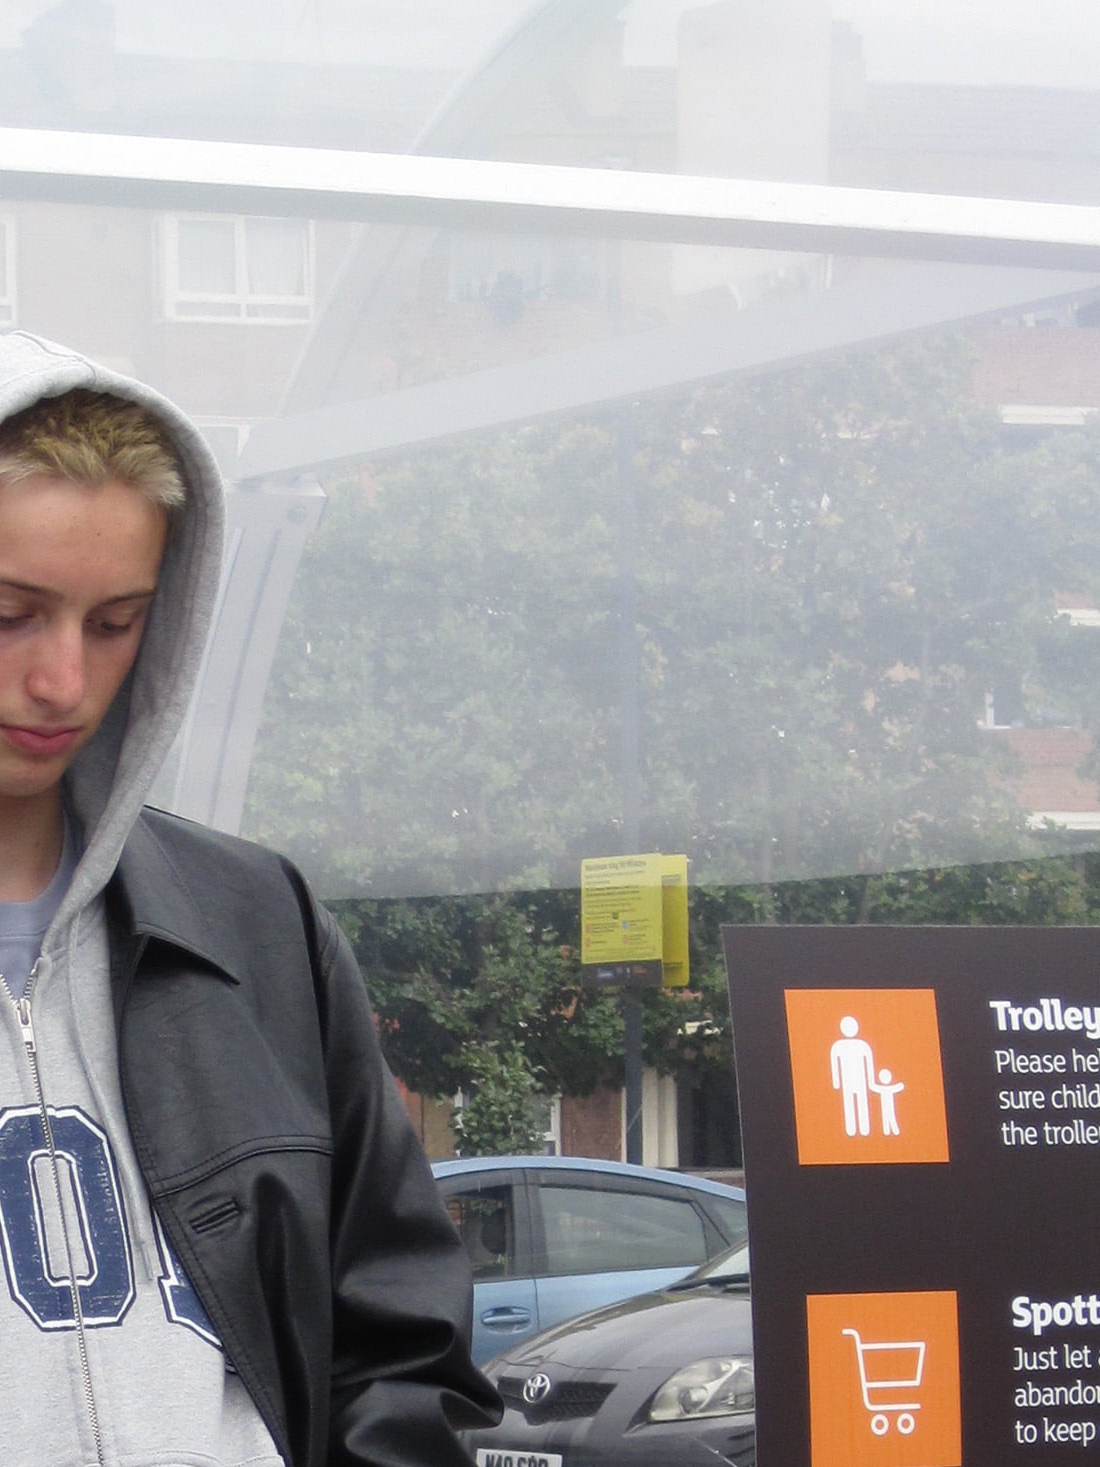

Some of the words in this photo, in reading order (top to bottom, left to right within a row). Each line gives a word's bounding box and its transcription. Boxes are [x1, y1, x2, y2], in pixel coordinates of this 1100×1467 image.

[989, 998, 1100, 1040] Trolley
[994, 1048, 1067, 1073] Please
[998, 1090, 1046, 1109] sure
[1001, 1120, 1038, 1146] the
[1043, 1119, 1100, 1145] trolle
[1013, 1346, 1058, 1371] Just
[1063, 1343, 1092, 1369] let
[1014, 1379, 1100, 1407] abando
[1015, 1420, 1037, 1444] to
[1042, 1416, 1096, 1447] keep
